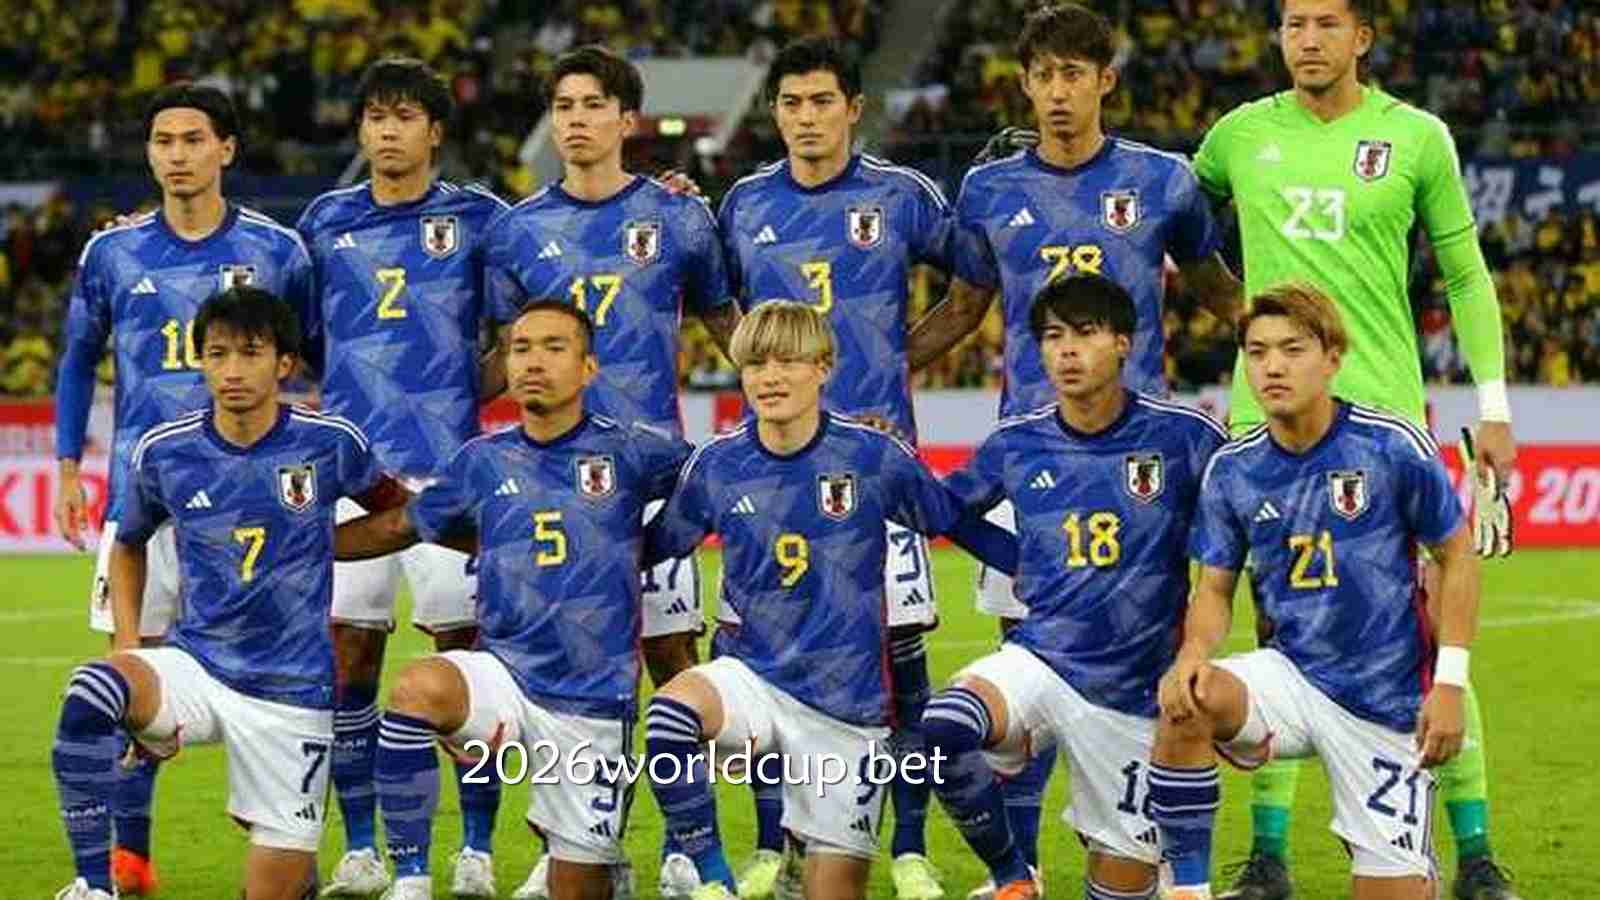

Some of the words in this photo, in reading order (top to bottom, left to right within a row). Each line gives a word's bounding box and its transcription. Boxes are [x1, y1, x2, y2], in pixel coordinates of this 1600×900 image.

[1281, 186, 1345, 240] 23
[376, 267, 407, 319] 2
[570, 275, 622, 327] 17
[800, 261, 831, 314] 3
[233, 527, 266, 583] 7
[533, 511, 567, 567] 5
[775, 532, 809, 587] 9
[889, 530, 921, 583] 3
[1061, 511, 1120, 568] 18
[1288, 530, 1339, 589] 21
[301, 741, 327, 793] 7
[1366, 756, 1420, 826] 21
